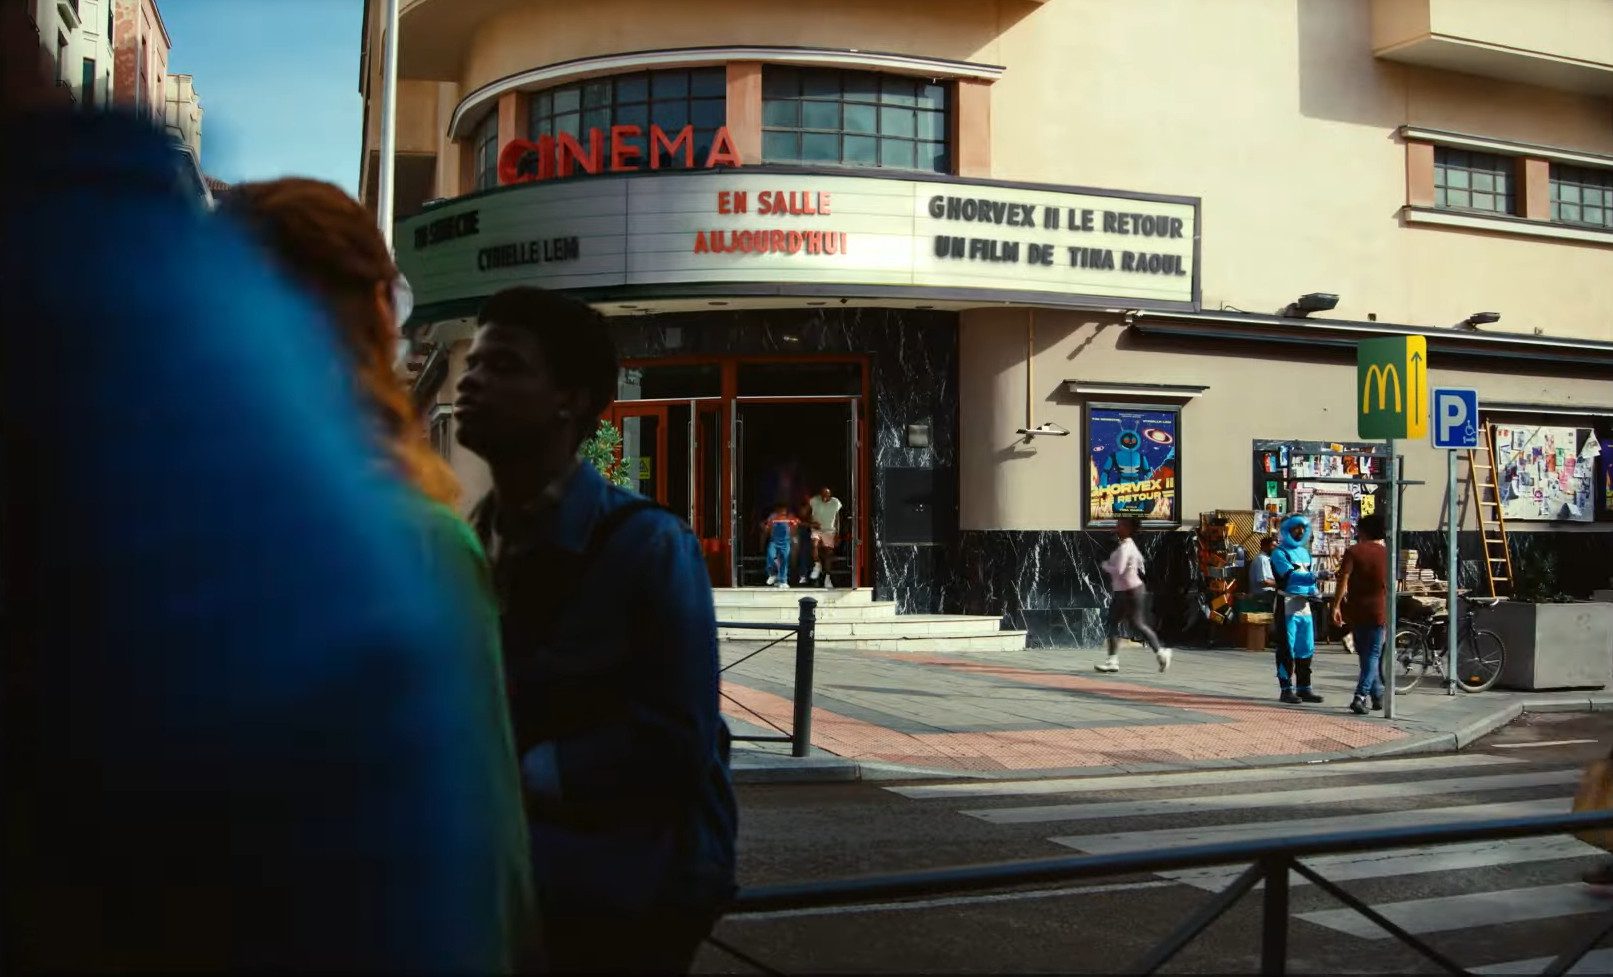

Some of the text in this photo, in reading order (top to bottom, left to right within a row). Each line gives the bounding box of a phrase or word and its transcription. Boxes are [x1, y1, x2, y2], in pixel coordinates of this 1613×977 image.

[497, 123, 742, 185] CINEMA
[718, 191, 832, 215] EN SALLE
[928, 195, 1035, 228] GHORVEX
[1068, 208, 1094, 232] LE
[1103, 210, 1184, 239] RETOUR
[694, 229, 847, 255] AUJOURD'HUI
[934, 234, 1187, 277] UN FILM DE TINA RAOUL
[1439, 394, 1468, 442] P
[1117, 490, 1162, 504] RETOUR
